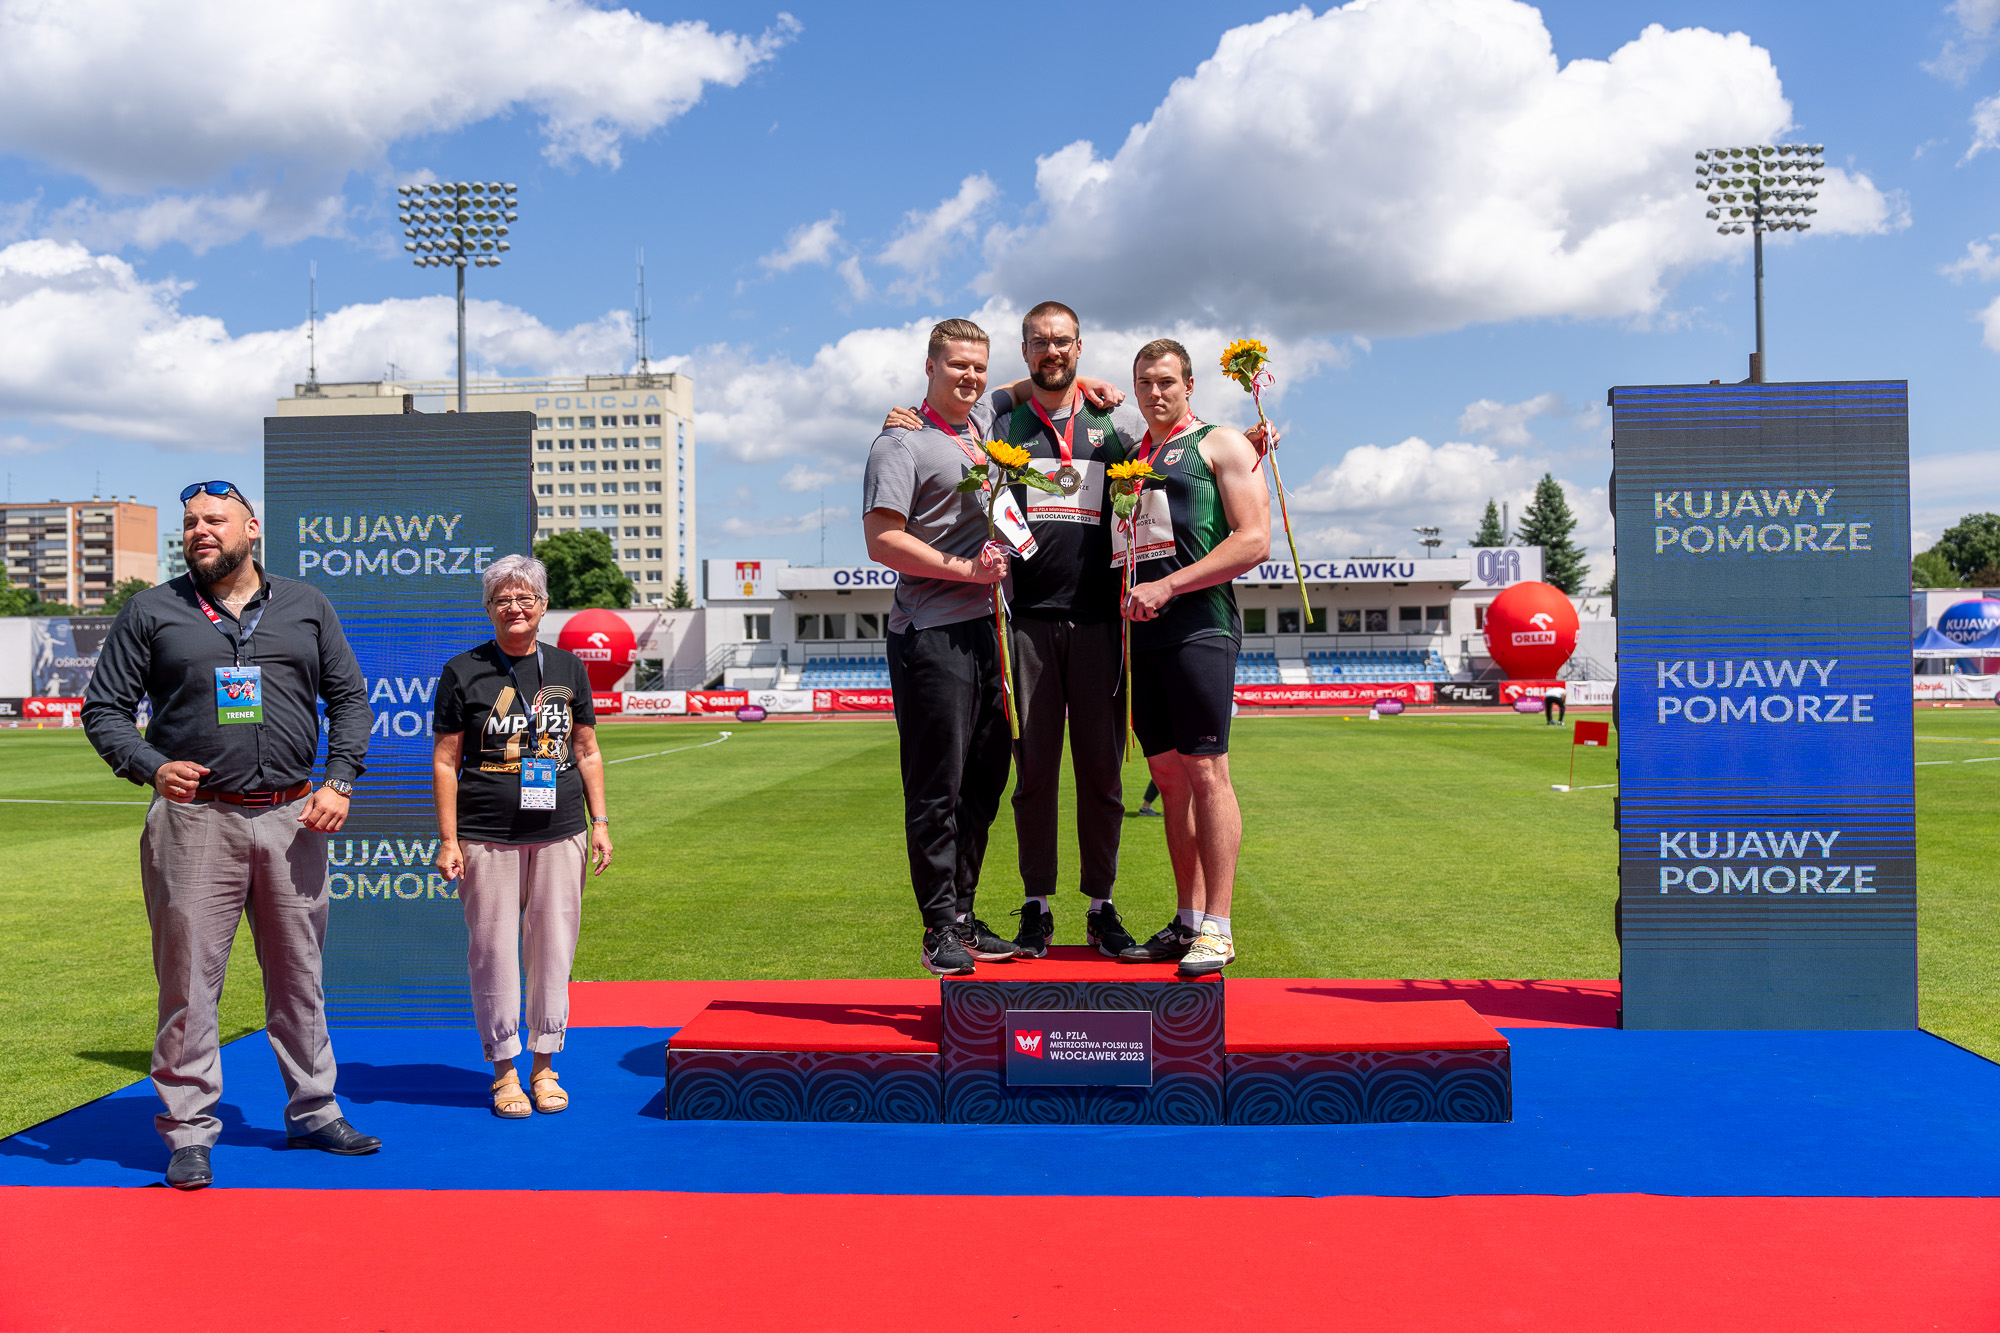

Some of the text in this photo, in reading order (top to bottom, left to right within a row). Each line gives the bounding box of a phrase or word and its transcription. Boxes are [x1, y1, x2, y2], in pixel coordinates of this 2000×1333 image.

[535, 394, 661, 410] POLICJA
[1655, 488, 1835, 519] KUJAWY
[299, 514, 462, 544] KUJAWY
[1655, 523, 1871, 554] POMORZE
[1151, 549, 1167, 557] 2023
[299, 547, 494, 577] POMORZE
[834, 567, 898, 585] OŚRO
[1259, 562, 1414, 580] WŁOCŁAWKU
[1946, 617, 2000, 631] KUJAWY
[1514, 633, 1552, 643] ORLEN
[55, 656, 99, 668] OŚRODE
[575, 651, 608, 659] ORLEN
[1658, 659, 1838, 688] KUJAWY
[1263, 690, 1312, 700] ZWIĄZEK
[1314, 689, 1356, 699] LEKKIEJ
[1358, 688, 1408, 698] ATLETYKI
[1453, 687, 1493, 700] FUEL
[46, 703, 81, 712] ORLEN
[627, 695, 671, 710] Reeco
[709, 696, 745, 706] ORLEN
[226, 711, 255, 719] TRENER
[531, 704, 568, 716] PZLA
[1658, 695, 1874, 724] POMORZE
[487, 716, 529, 735] MP
[1660, 830, 1840, 858] KUJAWY
[328, 839, 441, 866] UJAW
[328, 872, 459, 900] OMOR
[1660, 865, 1876, 894] POMORZE
[1194, 936, 1221, 949] NIKE
[1050, 1031, 1088, 1040] 40. PZLA
[1050, 1041, 1100, 1049] MISTRZOSTWA
[1102, 1041, 1128, 1049] POLSKI
[1050, 1051, 1144, 1061] WŁOCŁAWEK 2023
